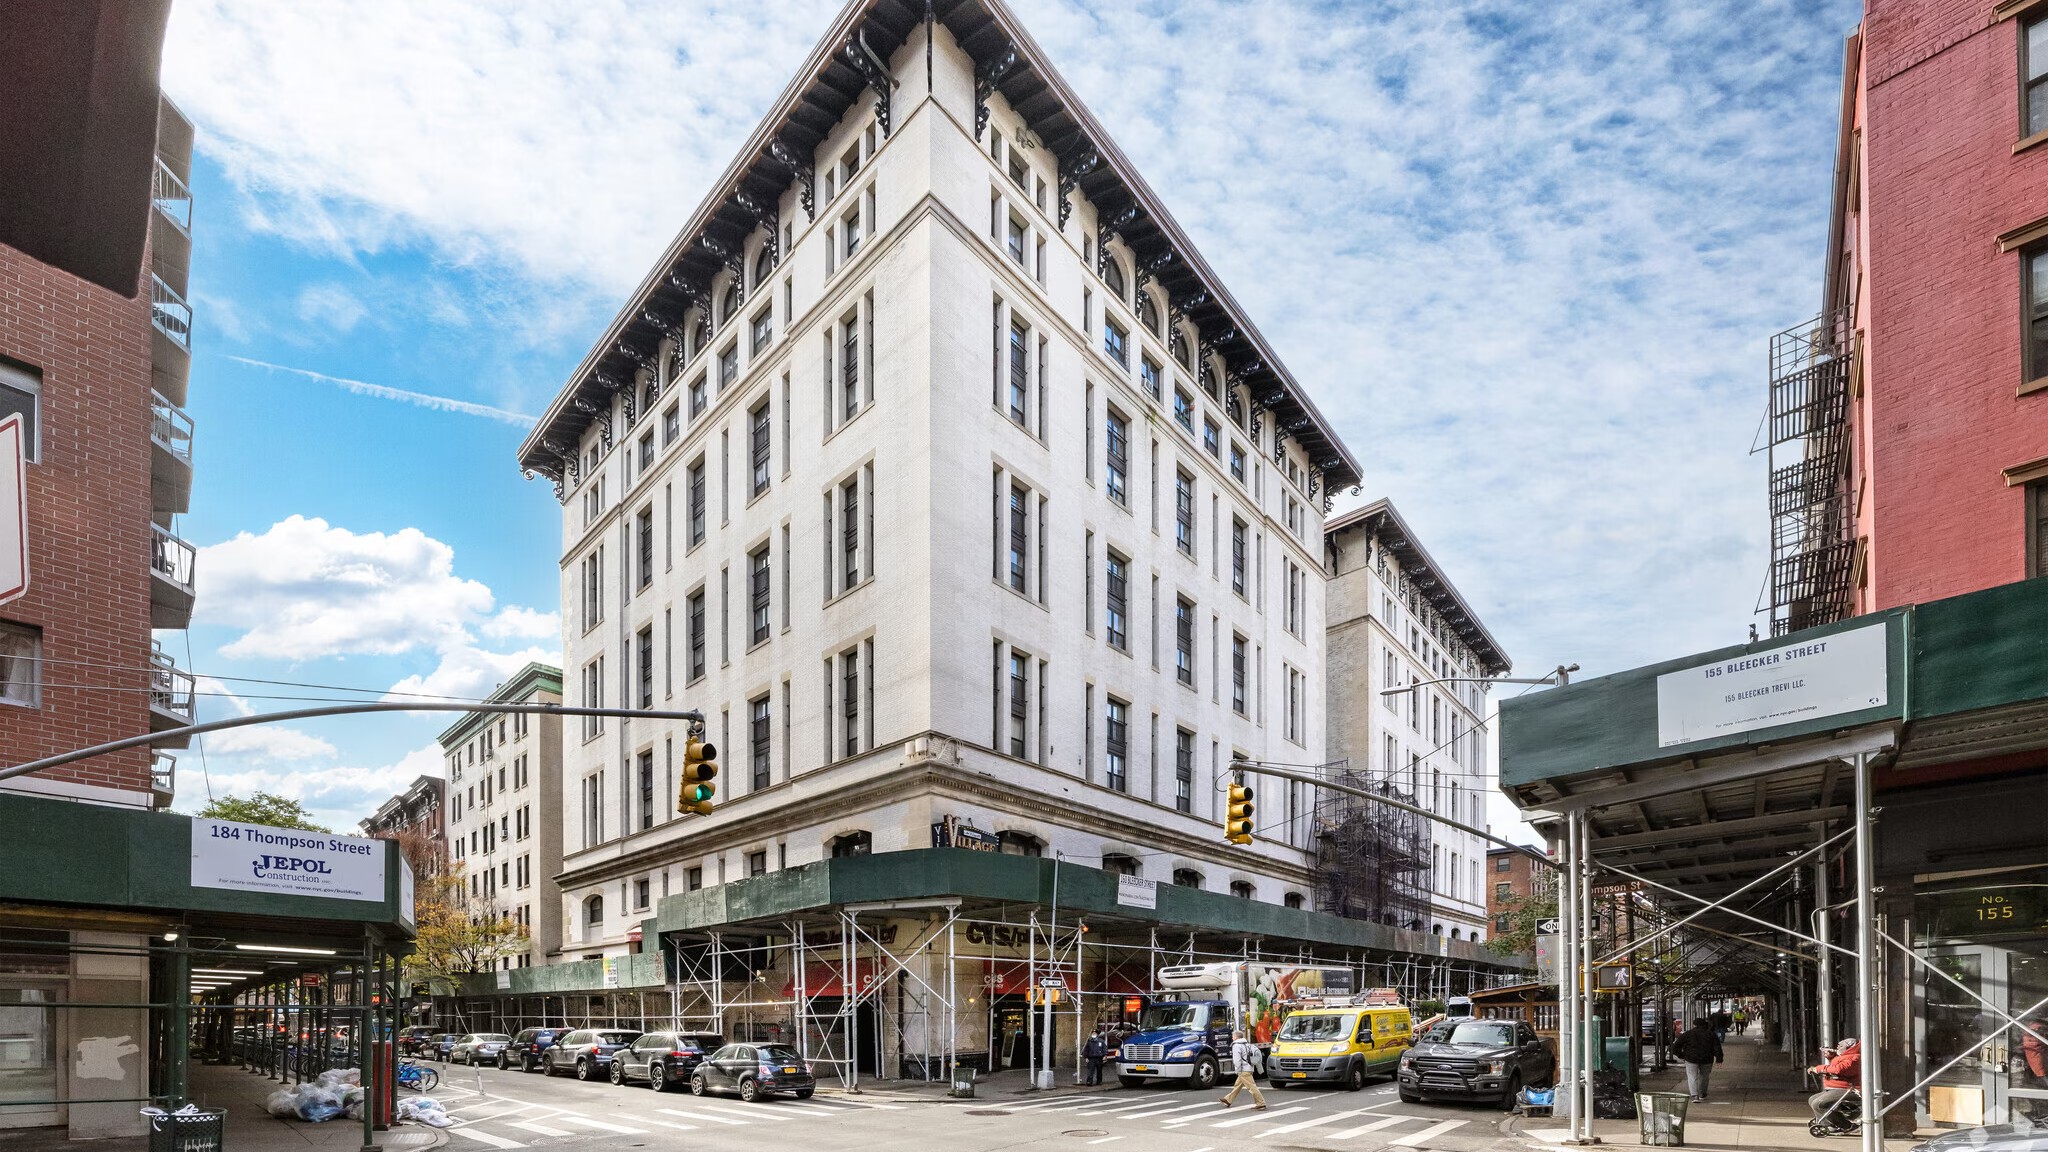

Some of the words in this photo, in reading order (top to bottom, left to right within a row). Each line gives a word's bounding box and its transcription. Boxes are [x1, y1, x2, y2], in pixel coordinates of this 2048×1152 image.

[1704, 666, 1722, 679] 155
[1727, 653, 1780, 674] BLEECKER
[1785, 642, 1827, 661] STREET
[1724, 694, 1736, 703] 155
[1737, 686, 1770, 701] BLEECKER
[1772, 682, 1790, 694] TREVI
[1792, 679, 1806, 689] LLC.
[210, 825, 240, 841] 184
[245, 829, 325, 850] Thompson
[329, 839, 372, 855] Street
[253, 866, 320, 883] Construction
[259, 854, 332, 875] JEPOL
[1630, 881, 1641, 890] St
[1976, 906, 2014, 920] 155
